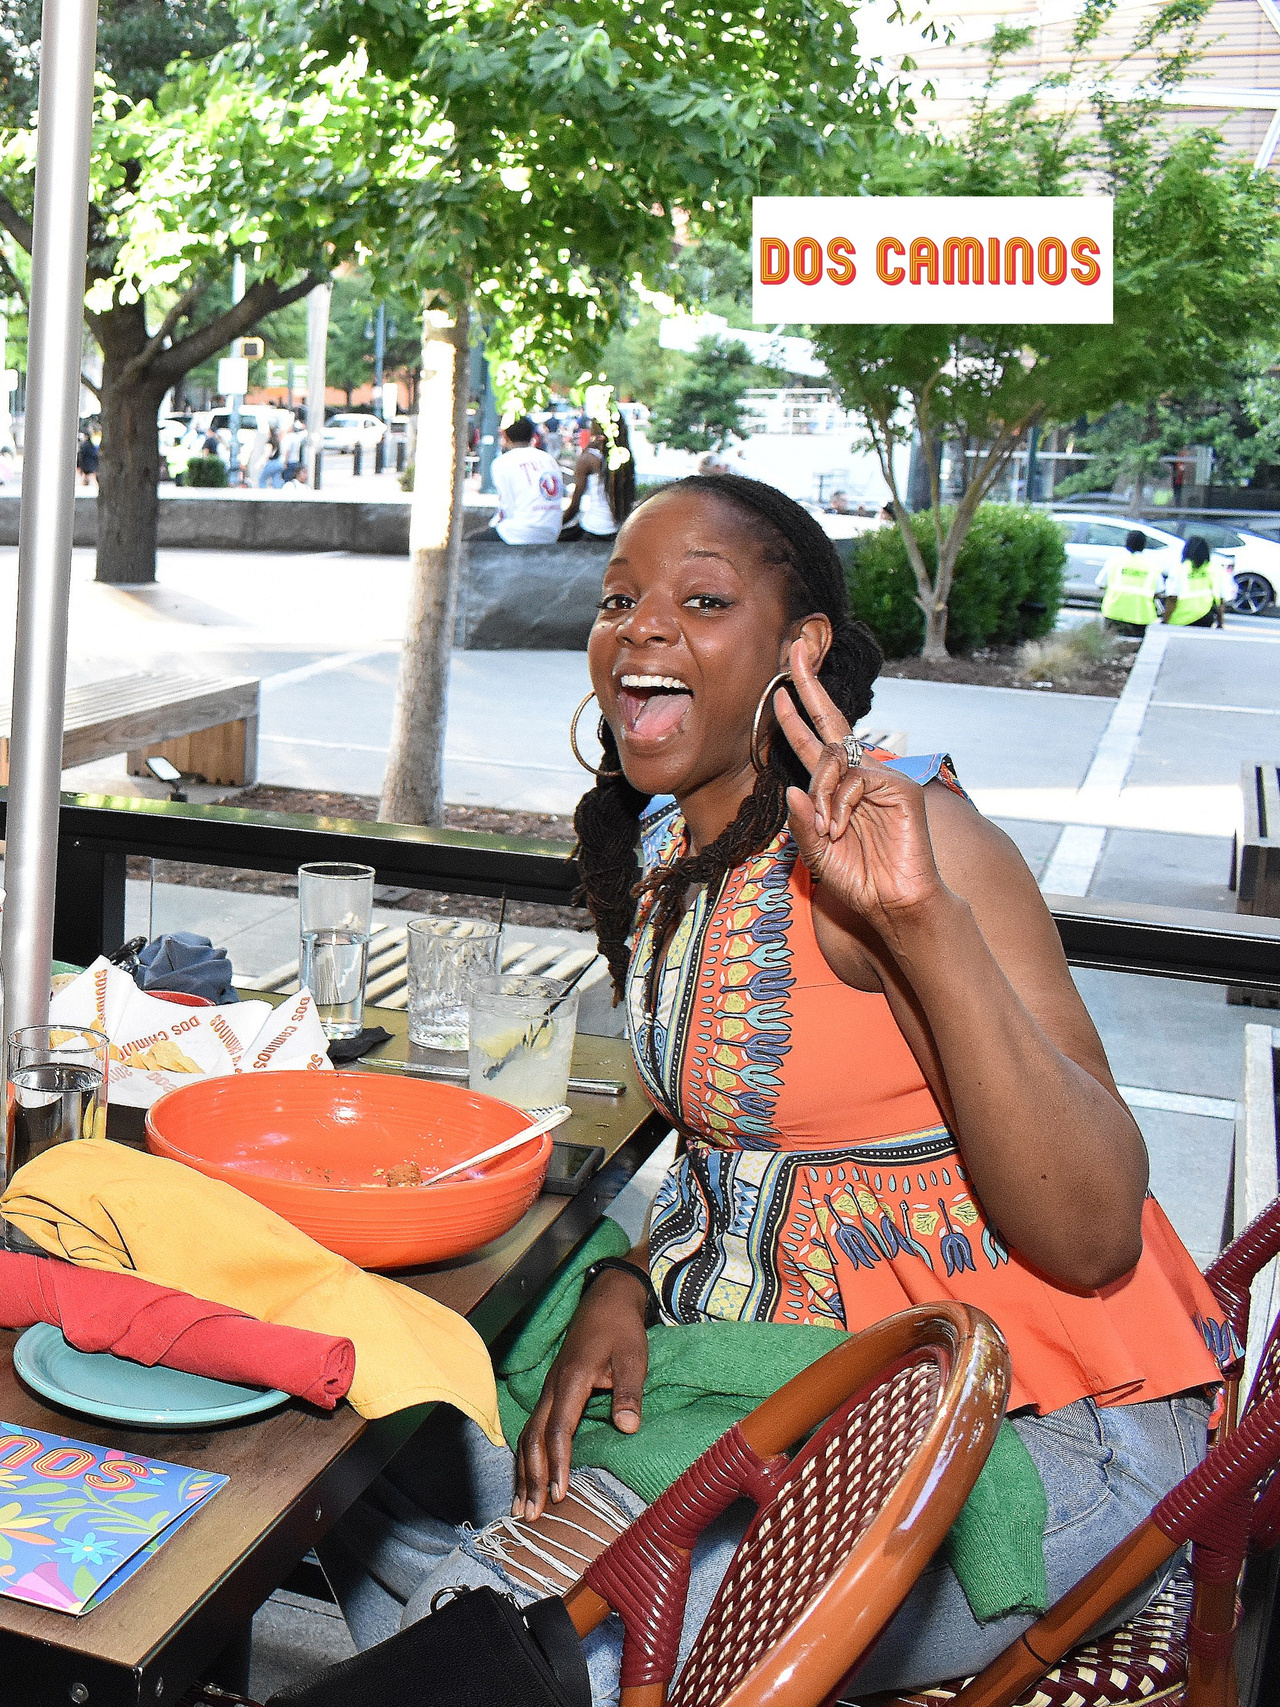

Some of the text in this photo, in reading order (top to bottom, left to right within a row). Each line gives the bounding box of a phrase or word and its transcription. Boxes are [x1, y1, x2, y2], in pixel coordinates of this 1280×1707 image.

[171, 1015, 201, 1035] DOS
[252, 996, 311, 1069] DOS CAMINOS
